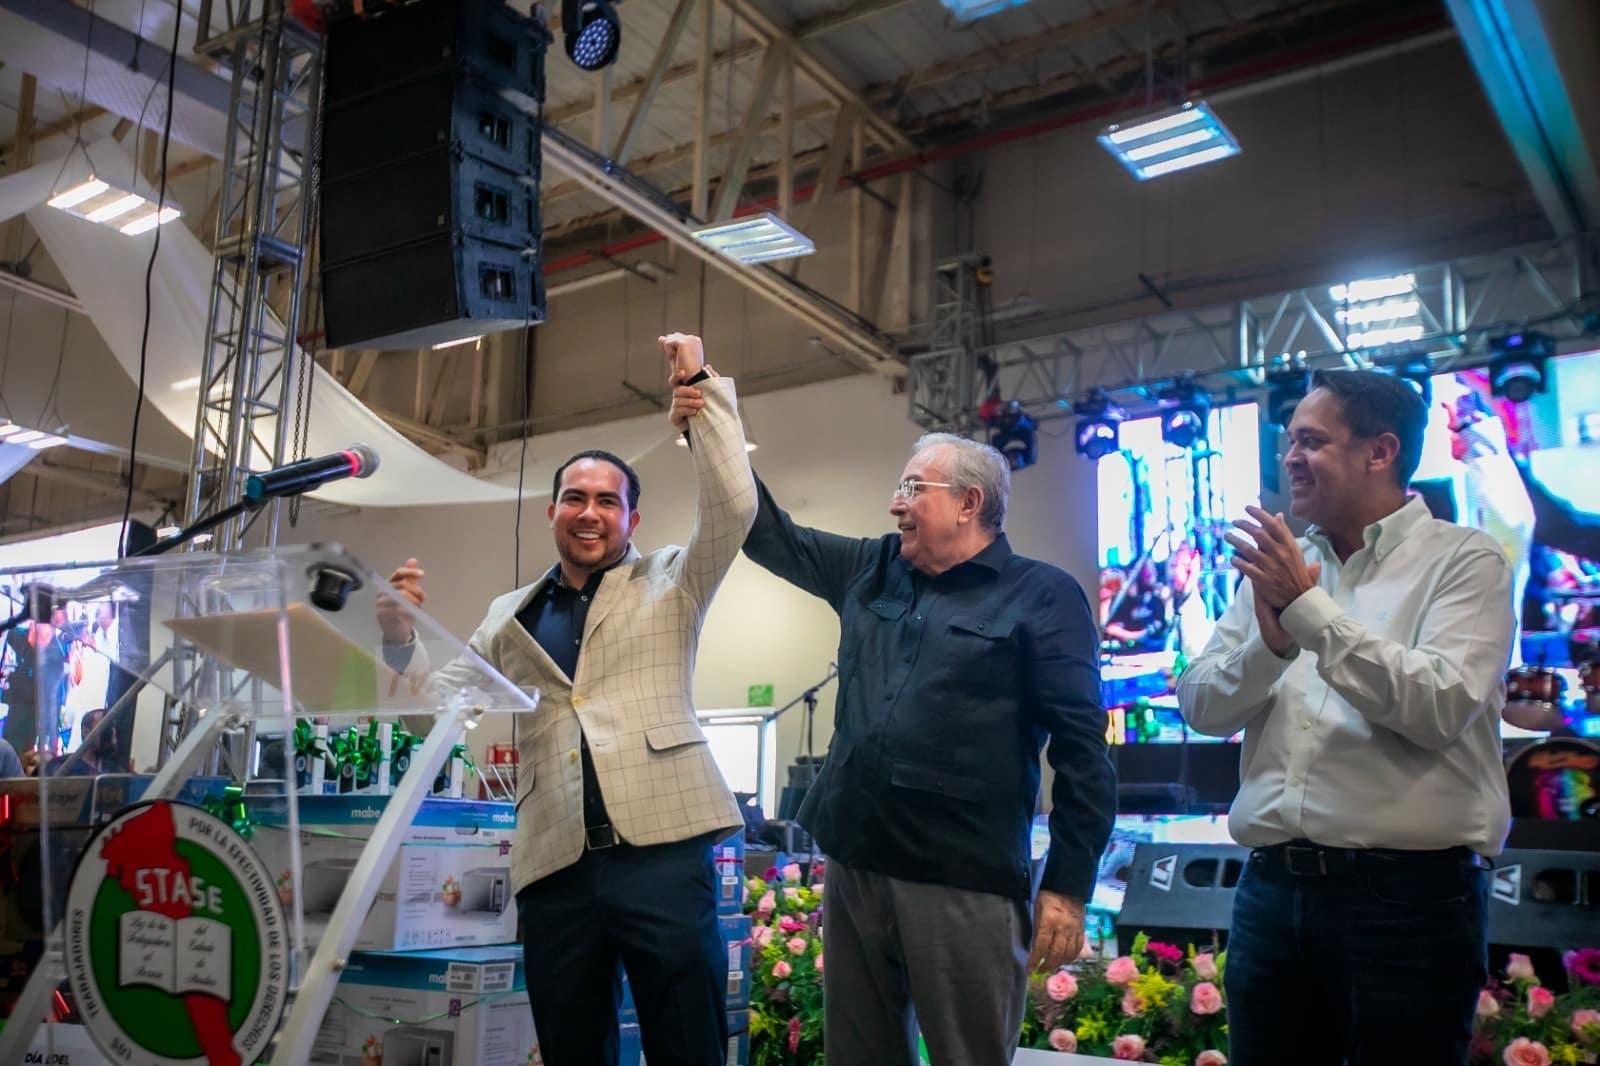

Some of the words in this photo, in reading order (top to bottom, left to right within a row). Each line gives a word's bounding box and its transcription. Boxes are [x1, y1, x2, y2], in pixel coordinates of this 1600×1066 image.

[351, 805, 381, 818] mabe
[492, 811, 515, 823] mabe
[188, 817, 213, 836] POR
[214, 831, 228, 848] LA
[136, 867, 224, 914] STASE
[228, 843, 276, 926] EFECTIVIDAD
[268, 930, 280, 949] DE
[72, 908, 99, 1019] TRABAJADORES
[269, 953, 282, 981] LOS
[242, 984, 279, 1052] DERECHOS
[24, 1049, 43, 1065] DÍA
